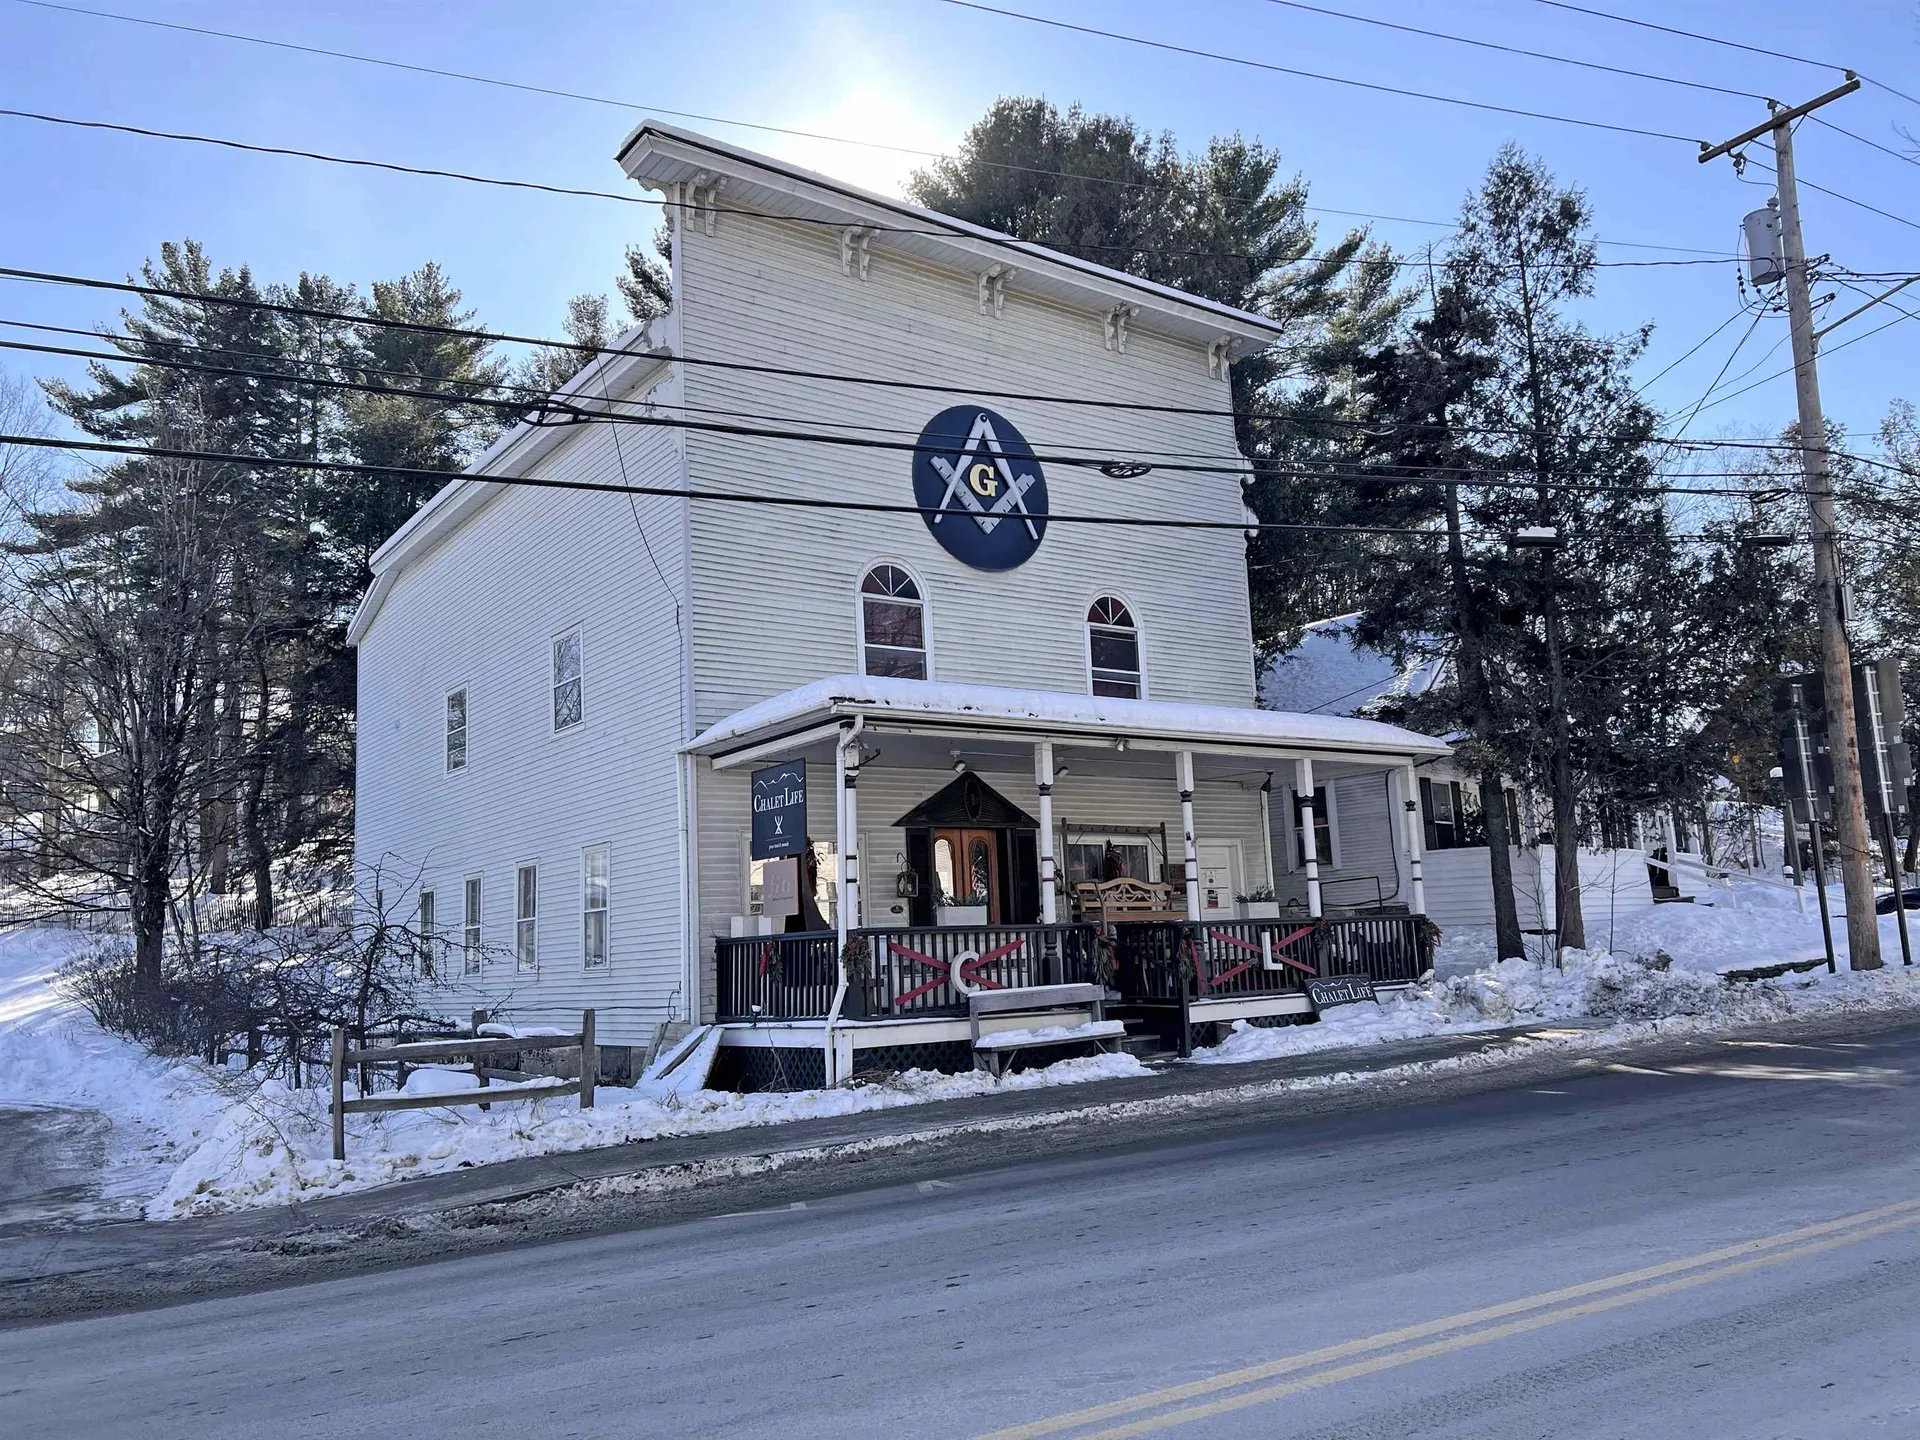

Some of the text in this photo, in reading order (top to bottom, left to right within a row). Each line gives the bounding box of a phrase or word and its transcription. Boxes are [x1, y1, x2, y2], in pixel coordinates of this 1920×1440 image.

[970, 463, 998, 497] G
[753, 787, 804, 812] CHALET LIFE
[1261, 931, 1283, 970] L
[950, 950, 980, 996] C
[1312, 982, 1373, 1004] CHALET LIFE
